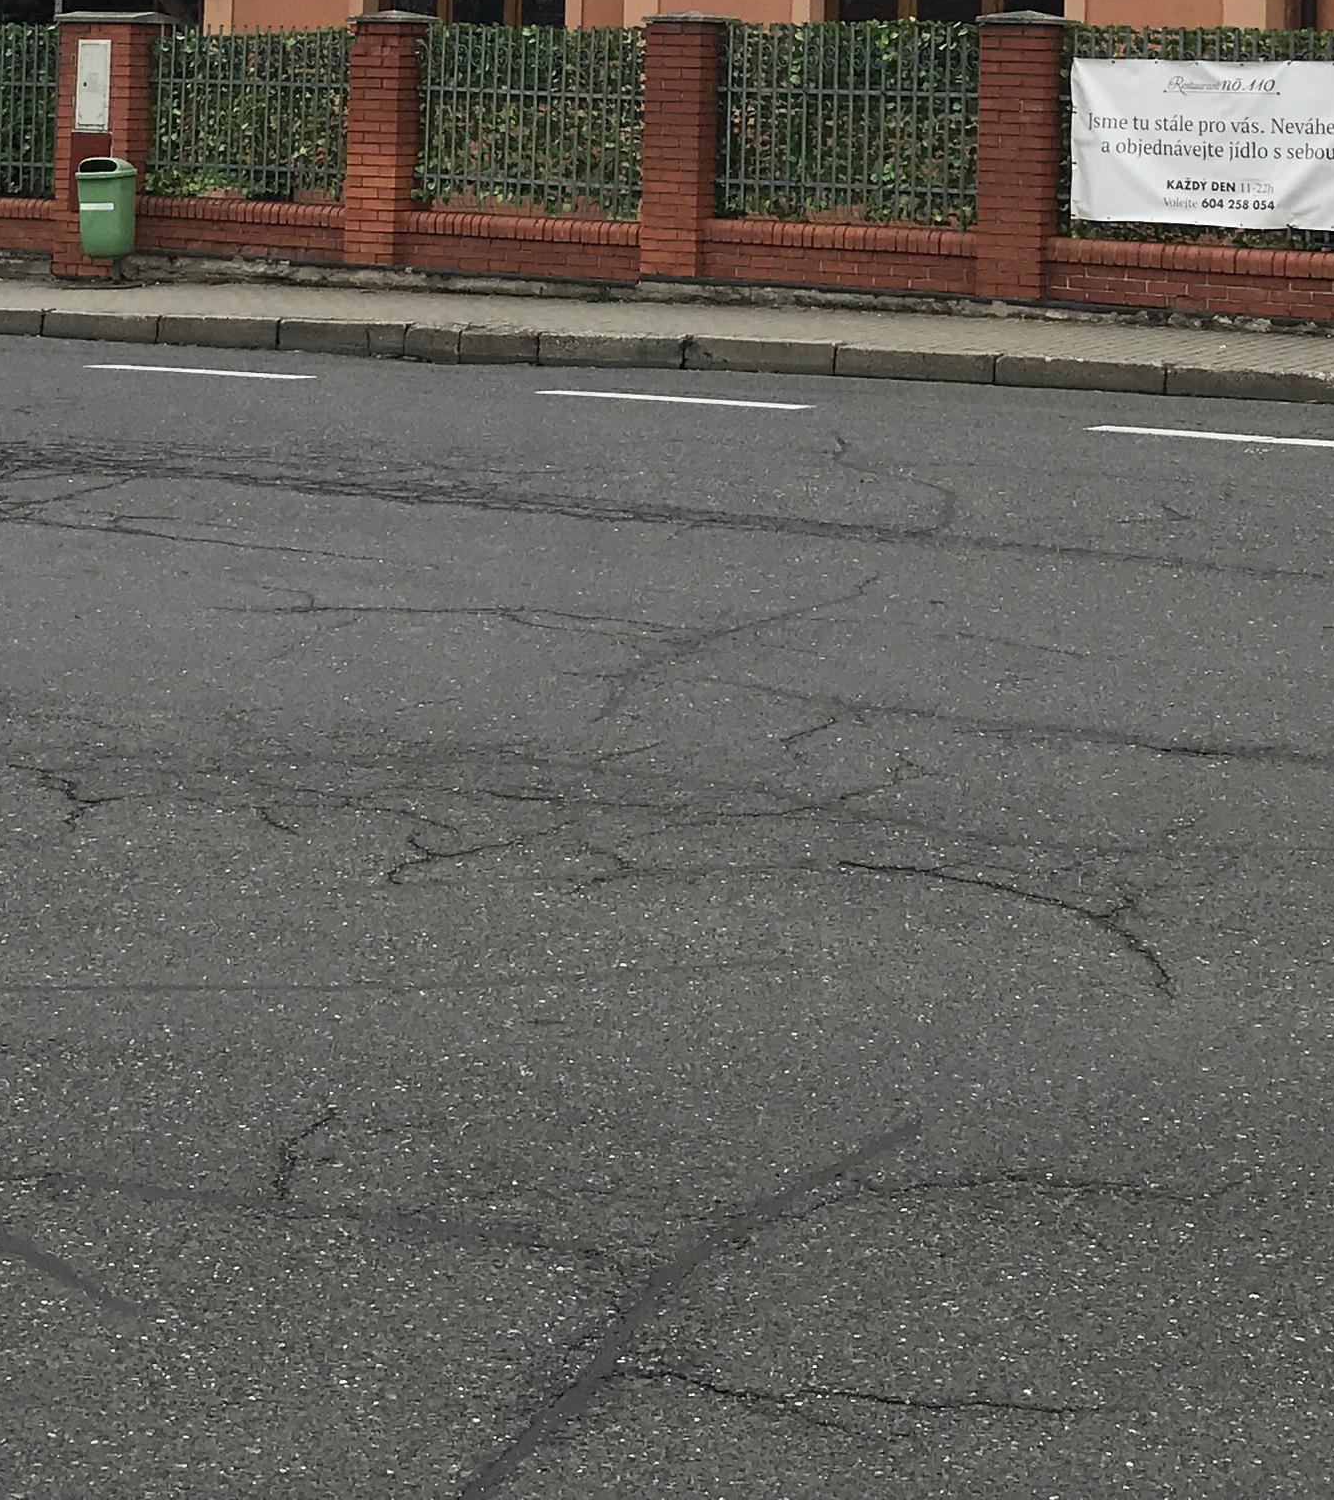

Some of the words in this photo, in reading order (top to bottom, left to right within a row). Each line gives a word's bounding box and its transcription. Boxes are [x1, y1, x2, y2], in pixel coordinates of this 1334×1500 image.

[1088, 112, 1128, 131] Jsme
[1132, 116, 1149, 130] tu
[1154, 114, 1194, 132] stále
[1198, 119, 1226, 136] pro
[1230, 116, 1265, 134] vás.
[1100, 140, 1110, 153] a
[1115, 137, 1224, 161] objednávejte
[1228, 141, 1268, 162] jídlo
[1273, 147, 1282, 159] s
[1166, 177, 1208, 191] KAŽDÝ
[1211, 181, 1236, 192] DEN
[1162, 196, 1198, 210] Volejte
[1201, 198, 1225, 209] 604
[1228, 199, 1249, 210] 258
[1252, 200, 1275, 210] 054
